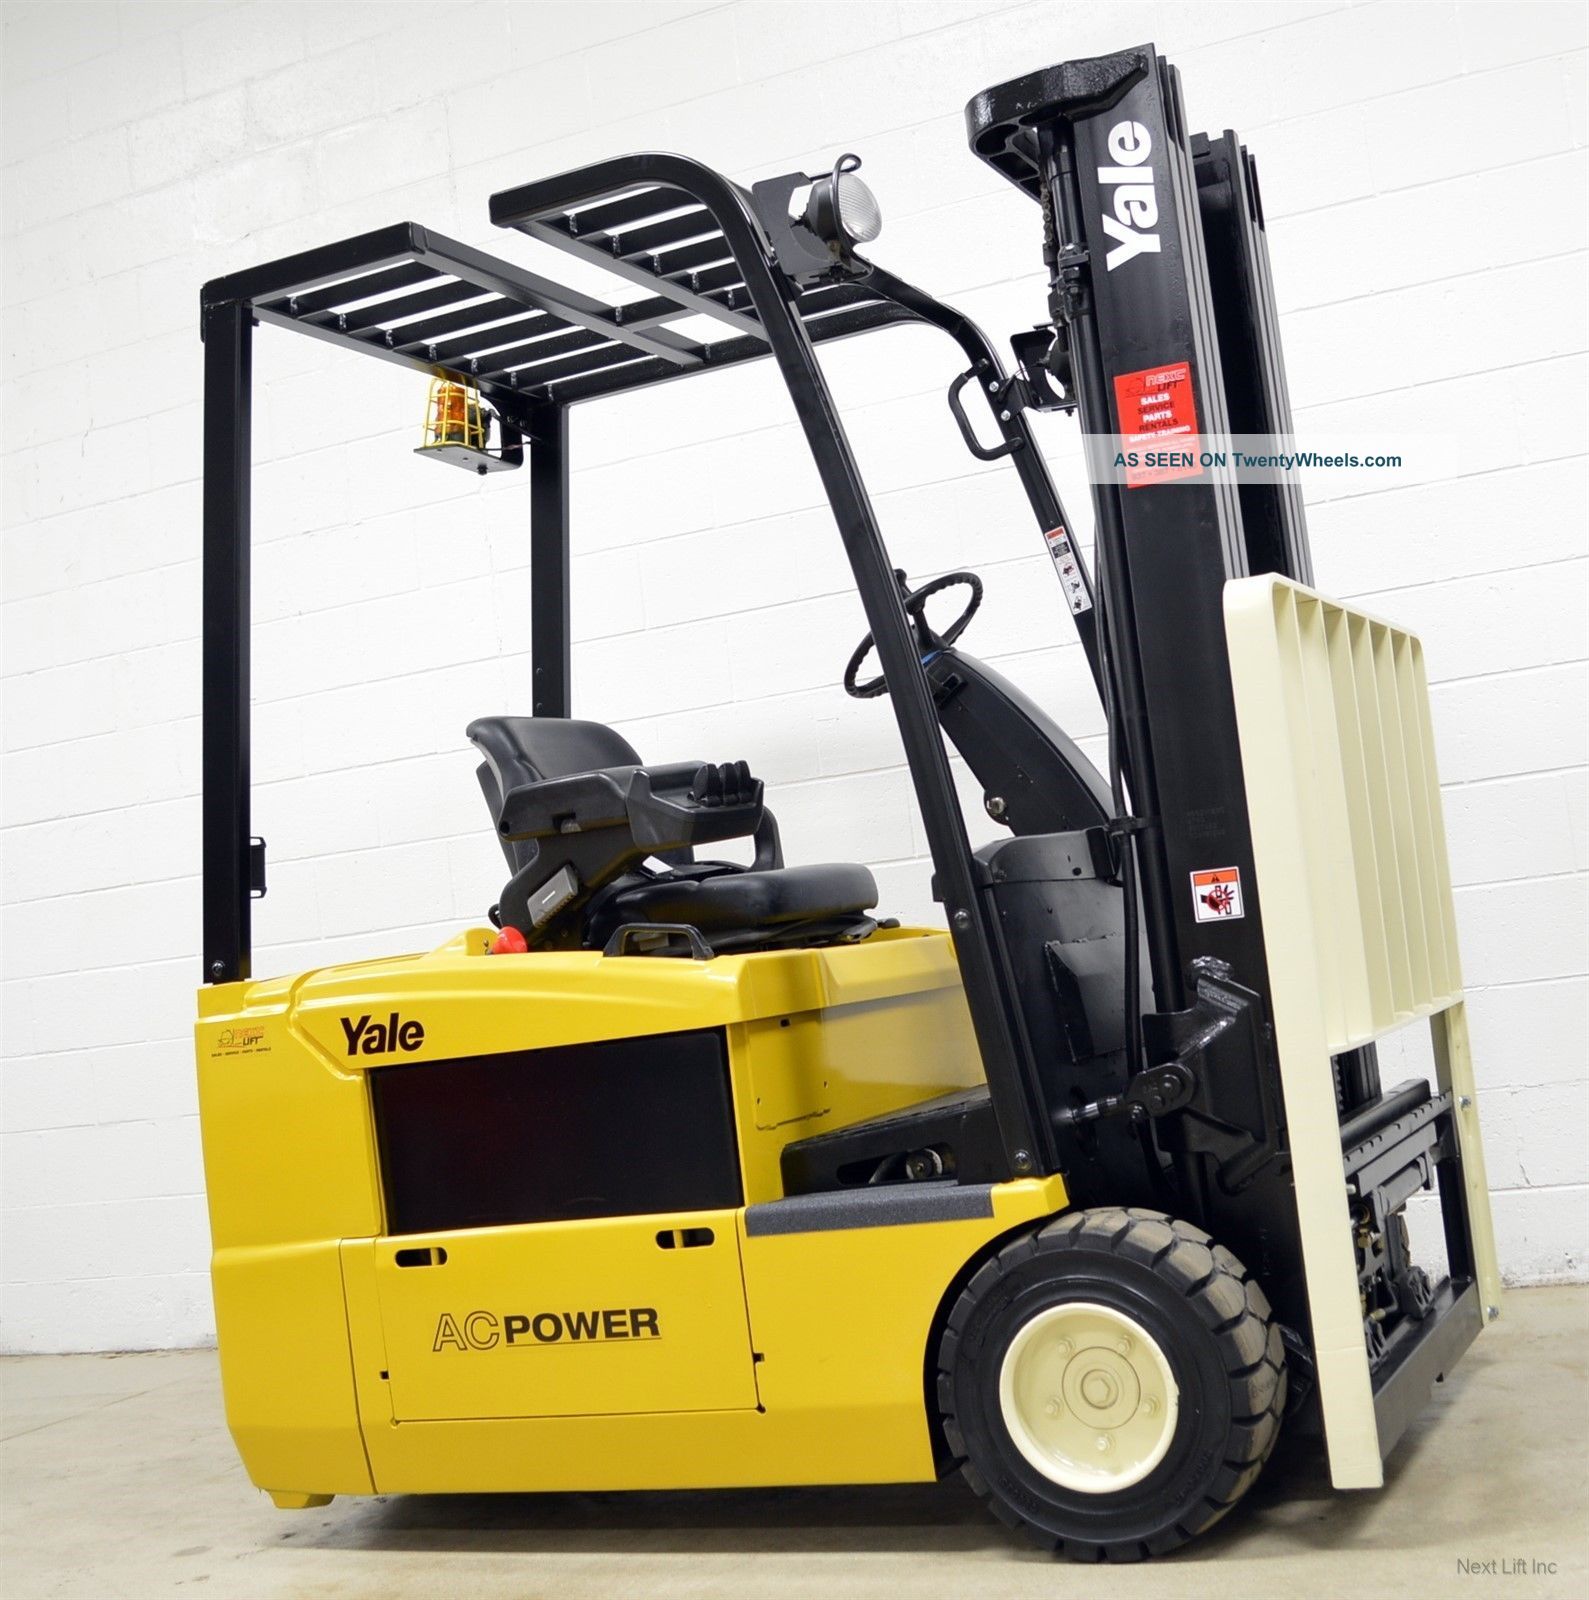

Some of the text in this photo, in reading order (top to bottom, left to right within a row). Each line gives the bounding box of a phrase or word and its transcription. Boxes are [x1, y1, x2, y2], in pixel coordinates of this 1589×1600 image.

[1097, 120, 1161, 272] Yale
[1140, 392, 1171, 405] SALES
[1137, 402, 1175, 415] SERVICE
[1142, 410, 1173, 423] PARTS
[1138, 418, 1179, 432] RENTALS
[340, 1012, 425, 1056] Yale
[432, 1308, 661, 1352] AC POWER
